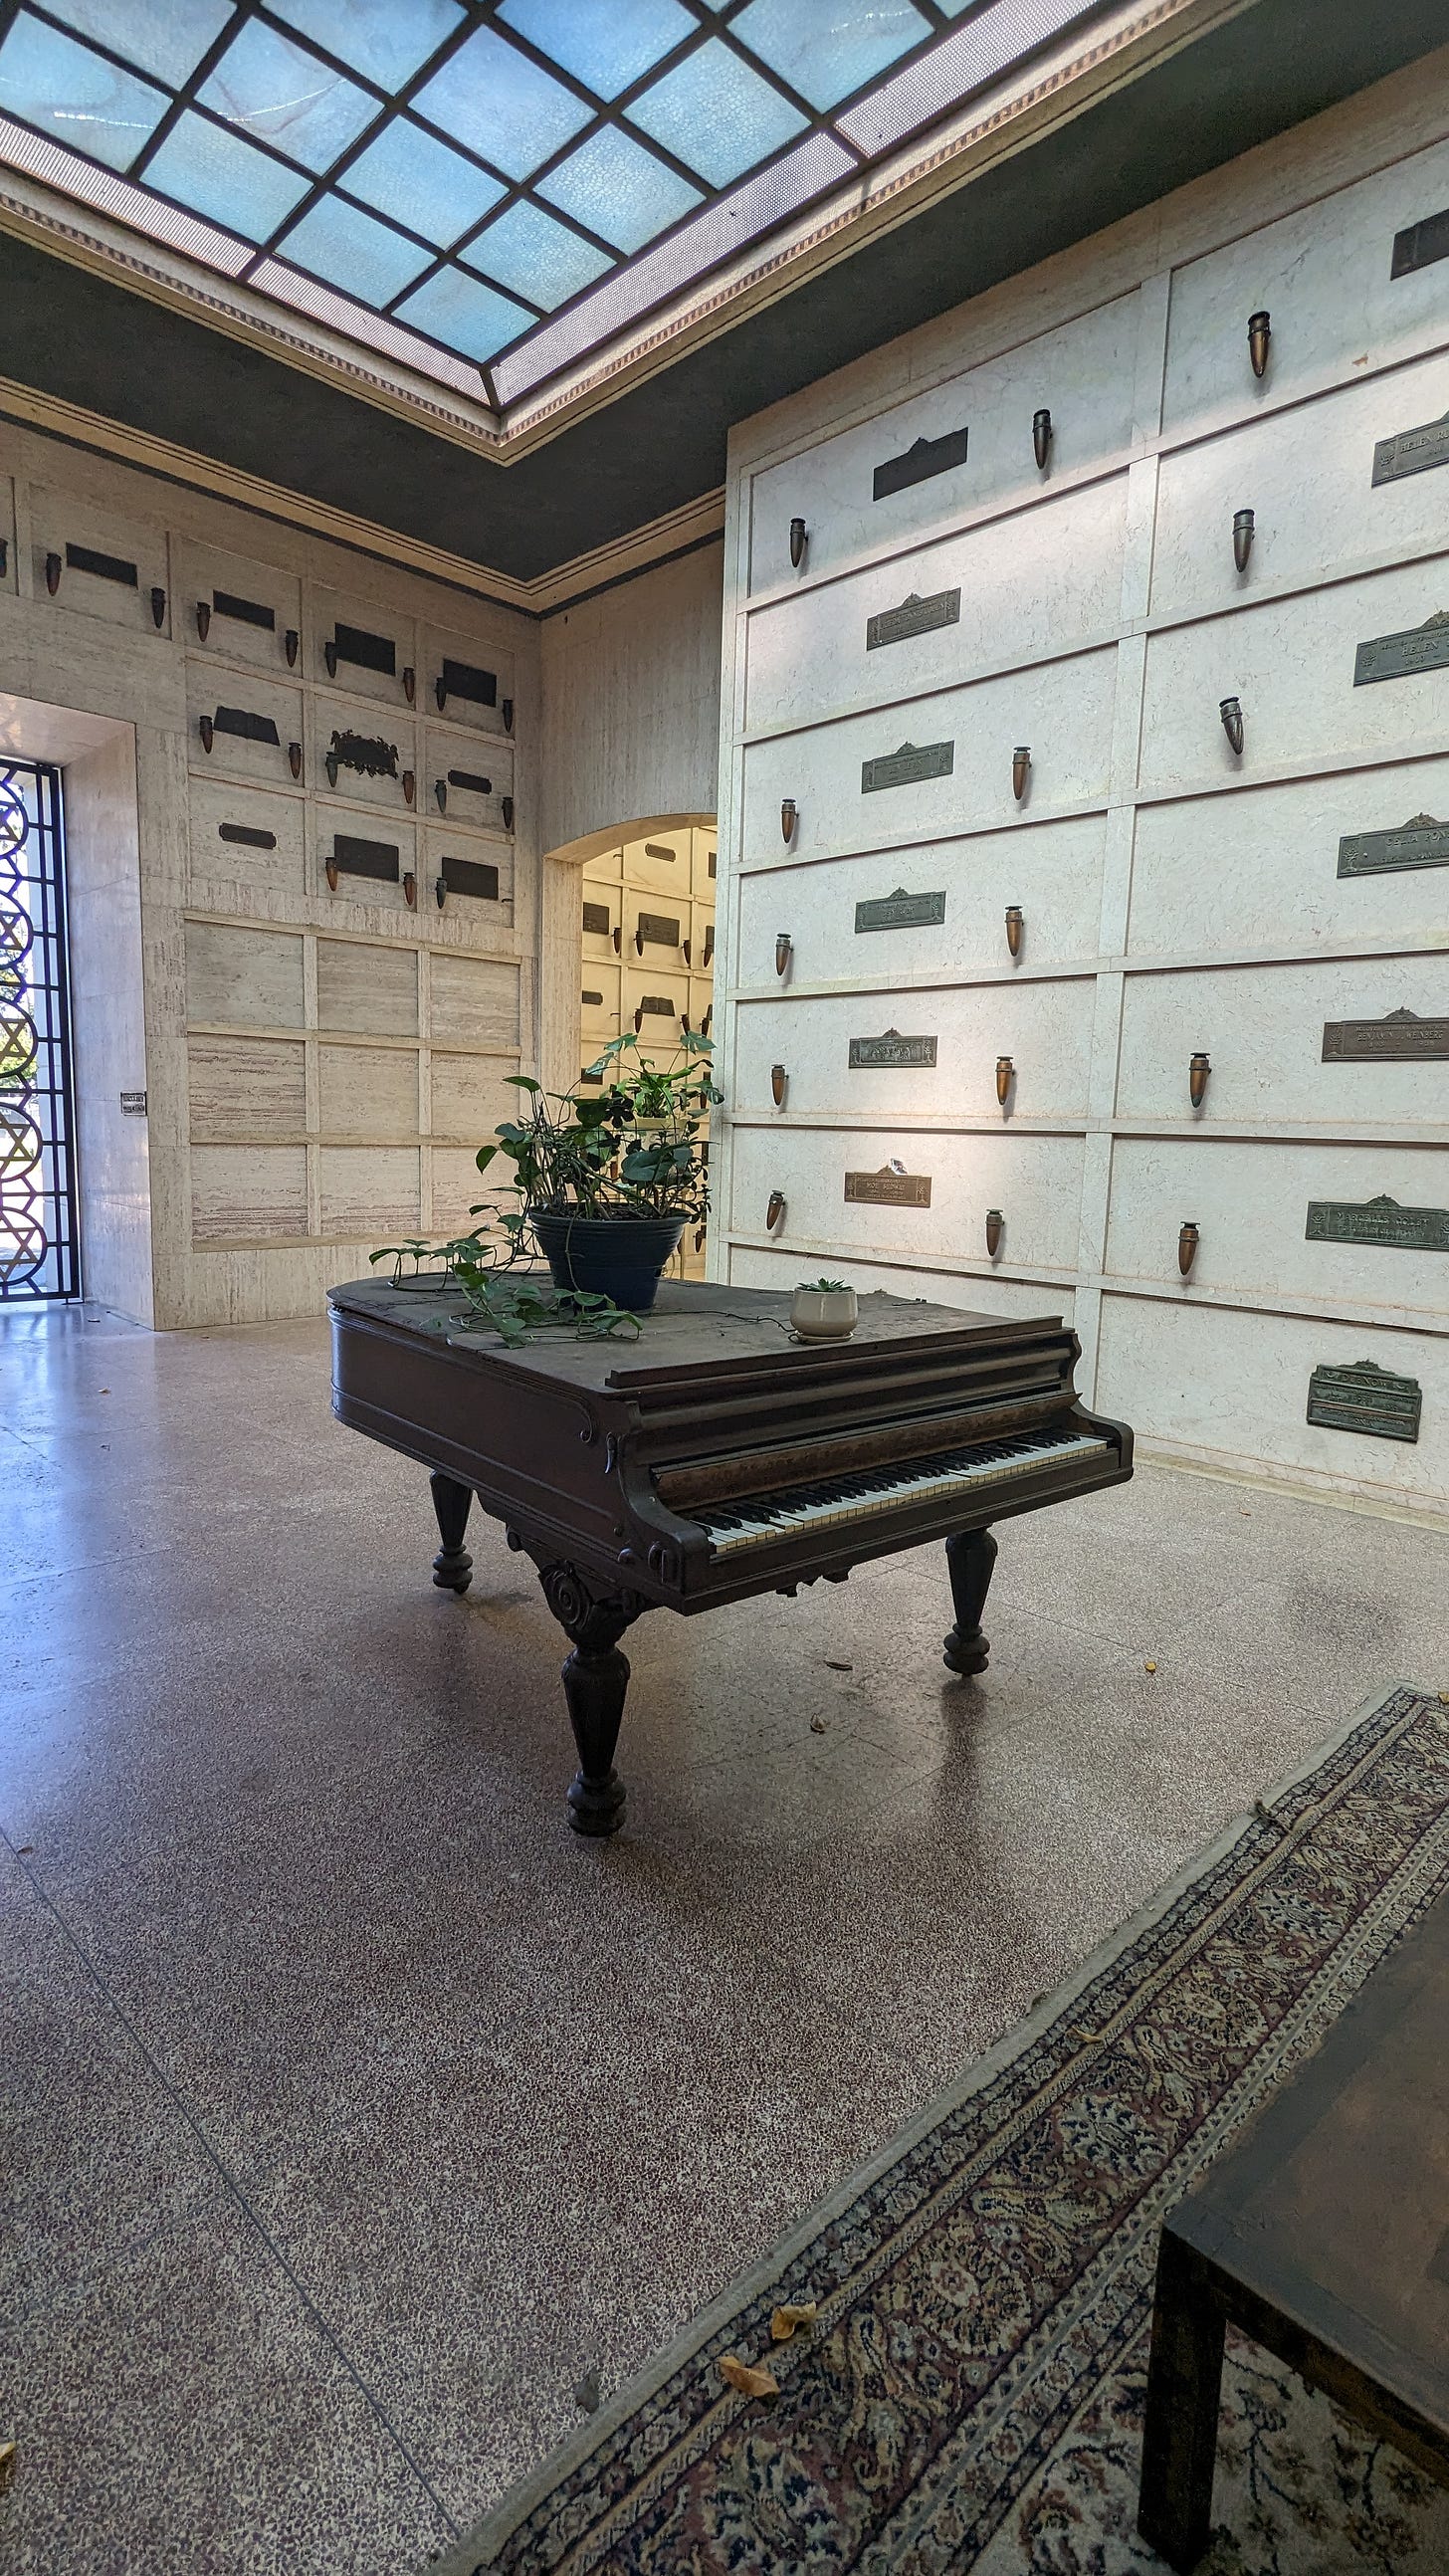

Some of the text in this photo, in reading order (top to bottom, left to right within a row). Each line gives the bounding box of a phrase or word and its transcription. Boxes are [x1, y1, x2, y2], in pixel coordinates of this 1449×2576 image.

[1400, 435, 1433, 453] HELEN
[1401, 641, 1439, 658] HELEN
[1425, 828, 1449, 843] PON
[1357, 1031, 1393, 1042] BENJAMIN
[1406, 1029, 1444, 1040] WEINBERG
